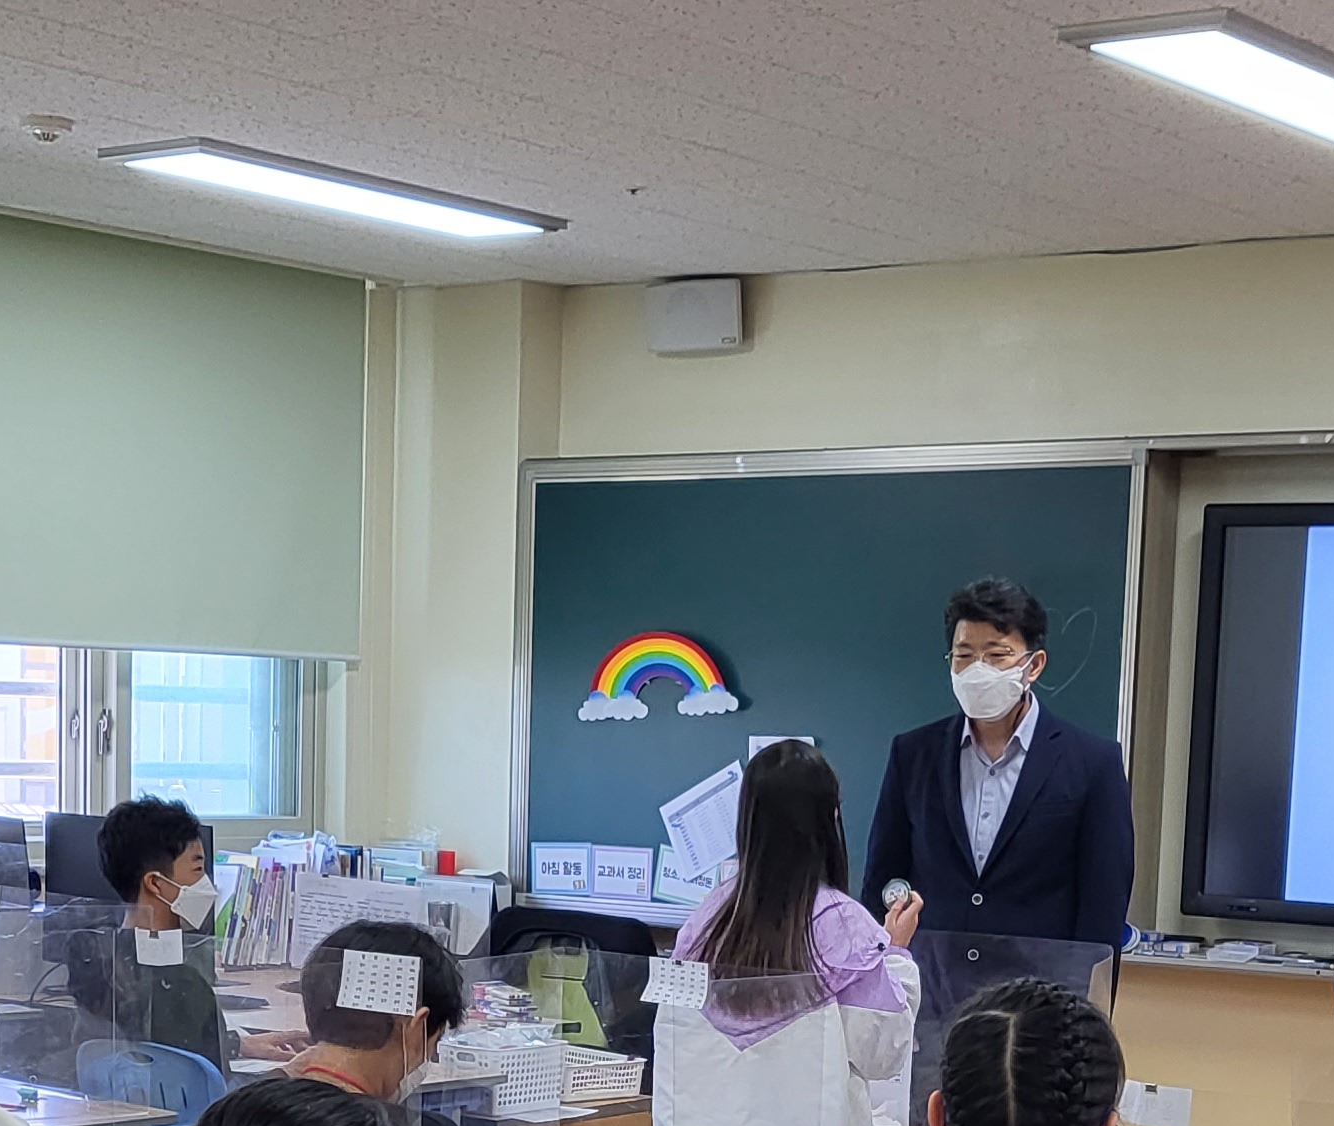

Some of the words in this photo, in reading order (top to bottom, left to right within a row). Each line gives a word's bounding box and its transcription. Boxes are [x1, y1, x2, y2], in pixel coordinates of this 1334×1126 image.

[541, 861, 560, 876] 아침
[562, 861, 582, 876] 활동
[597, 865, 624, 879] 교과서
[627, 866, 645, 880] 정리
[682, 875, 714, 889] 정돈
